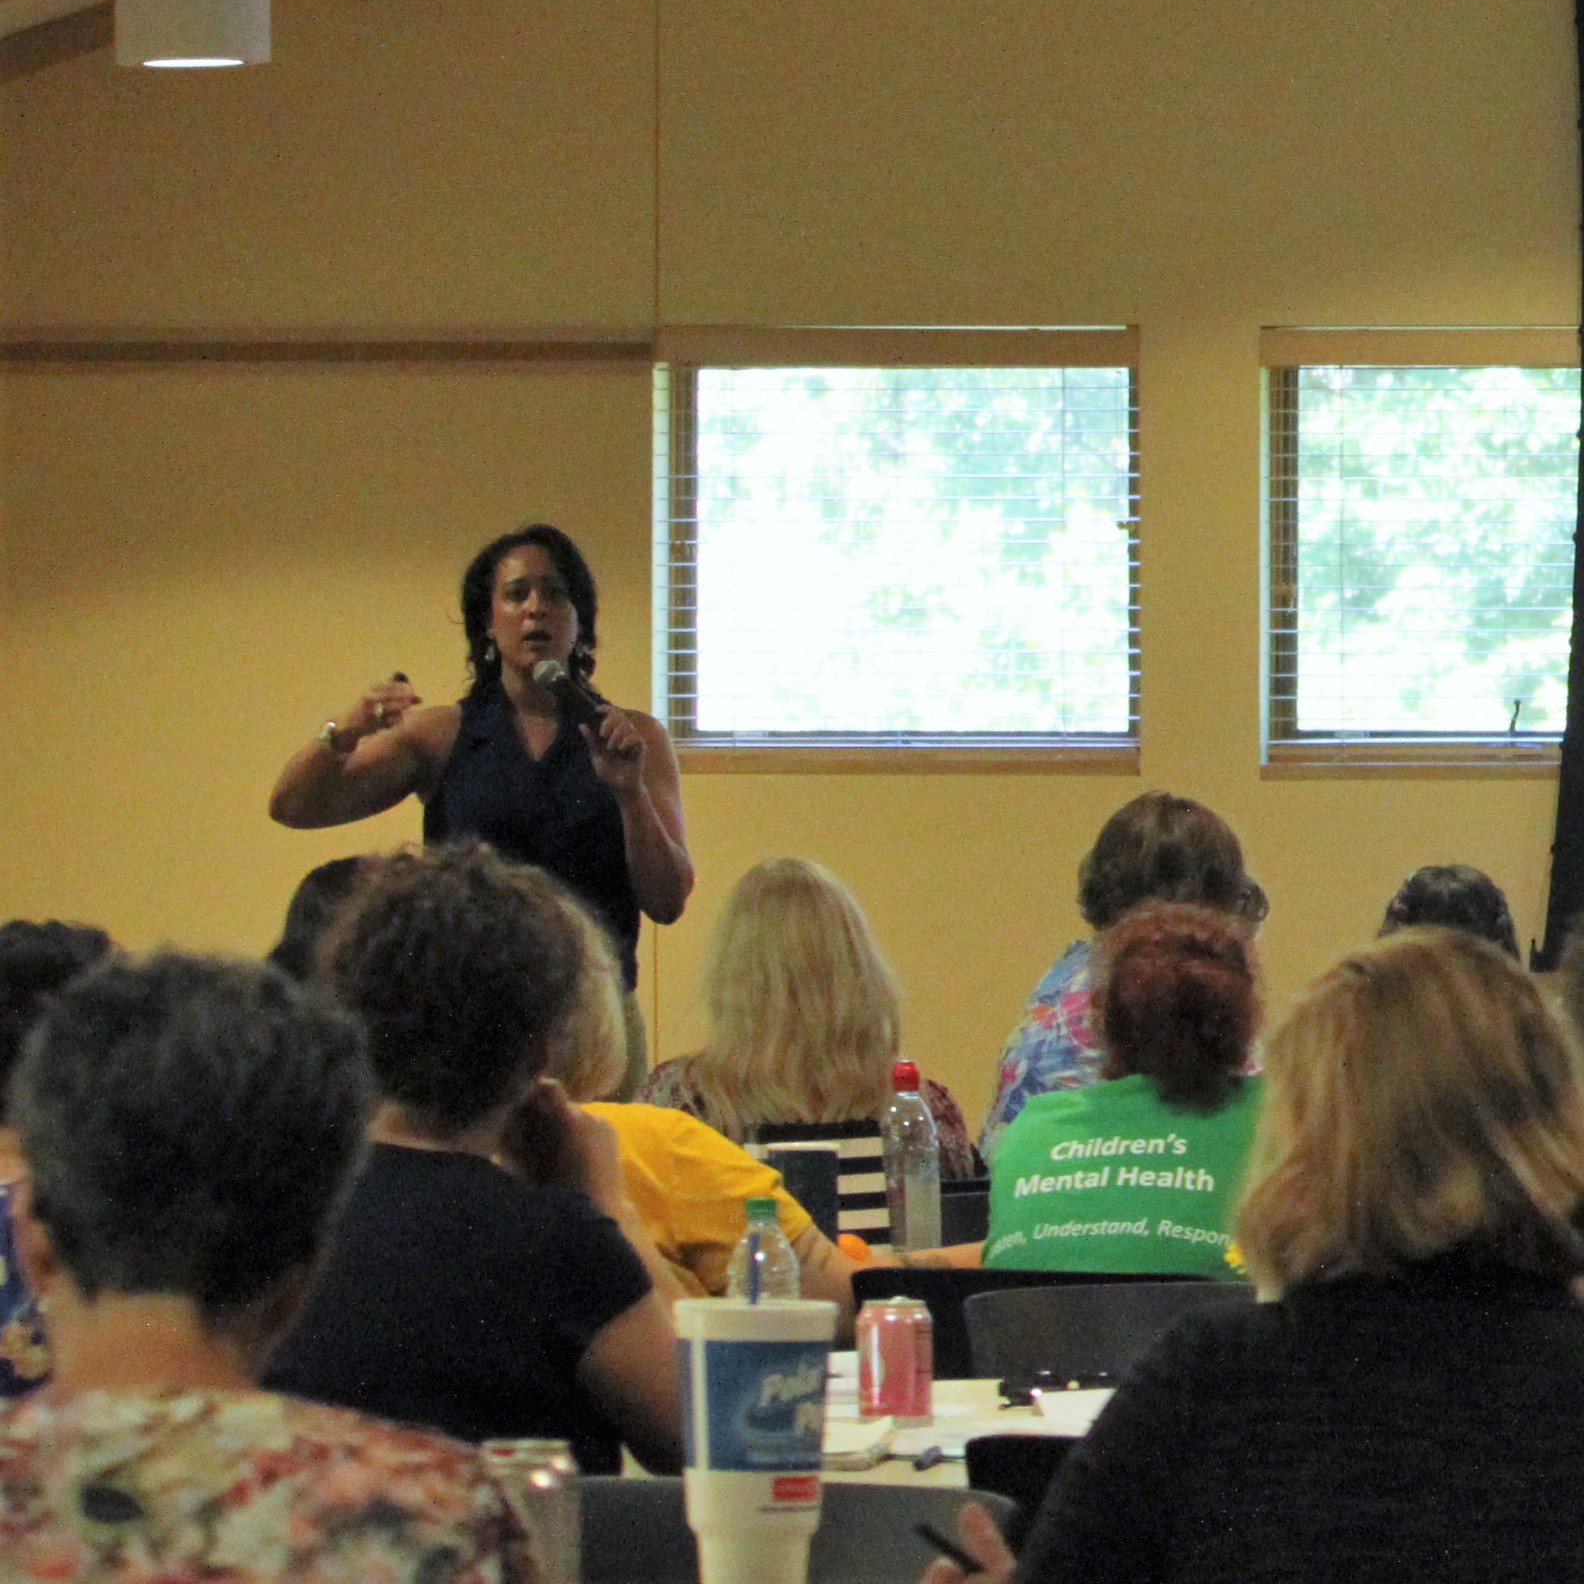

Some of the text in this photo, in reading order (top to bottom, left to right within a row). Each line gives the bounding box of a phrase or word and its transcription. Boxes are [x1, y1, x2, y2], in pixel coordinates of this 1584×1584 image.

[1050, 1133, 1188, 1161] Children’s
[1013, 1166, 1215, 1199] Mental Health
[1032, 1217, 1149, 1240] Understand,
[1157, 1219, 1231, 1247] Respon
